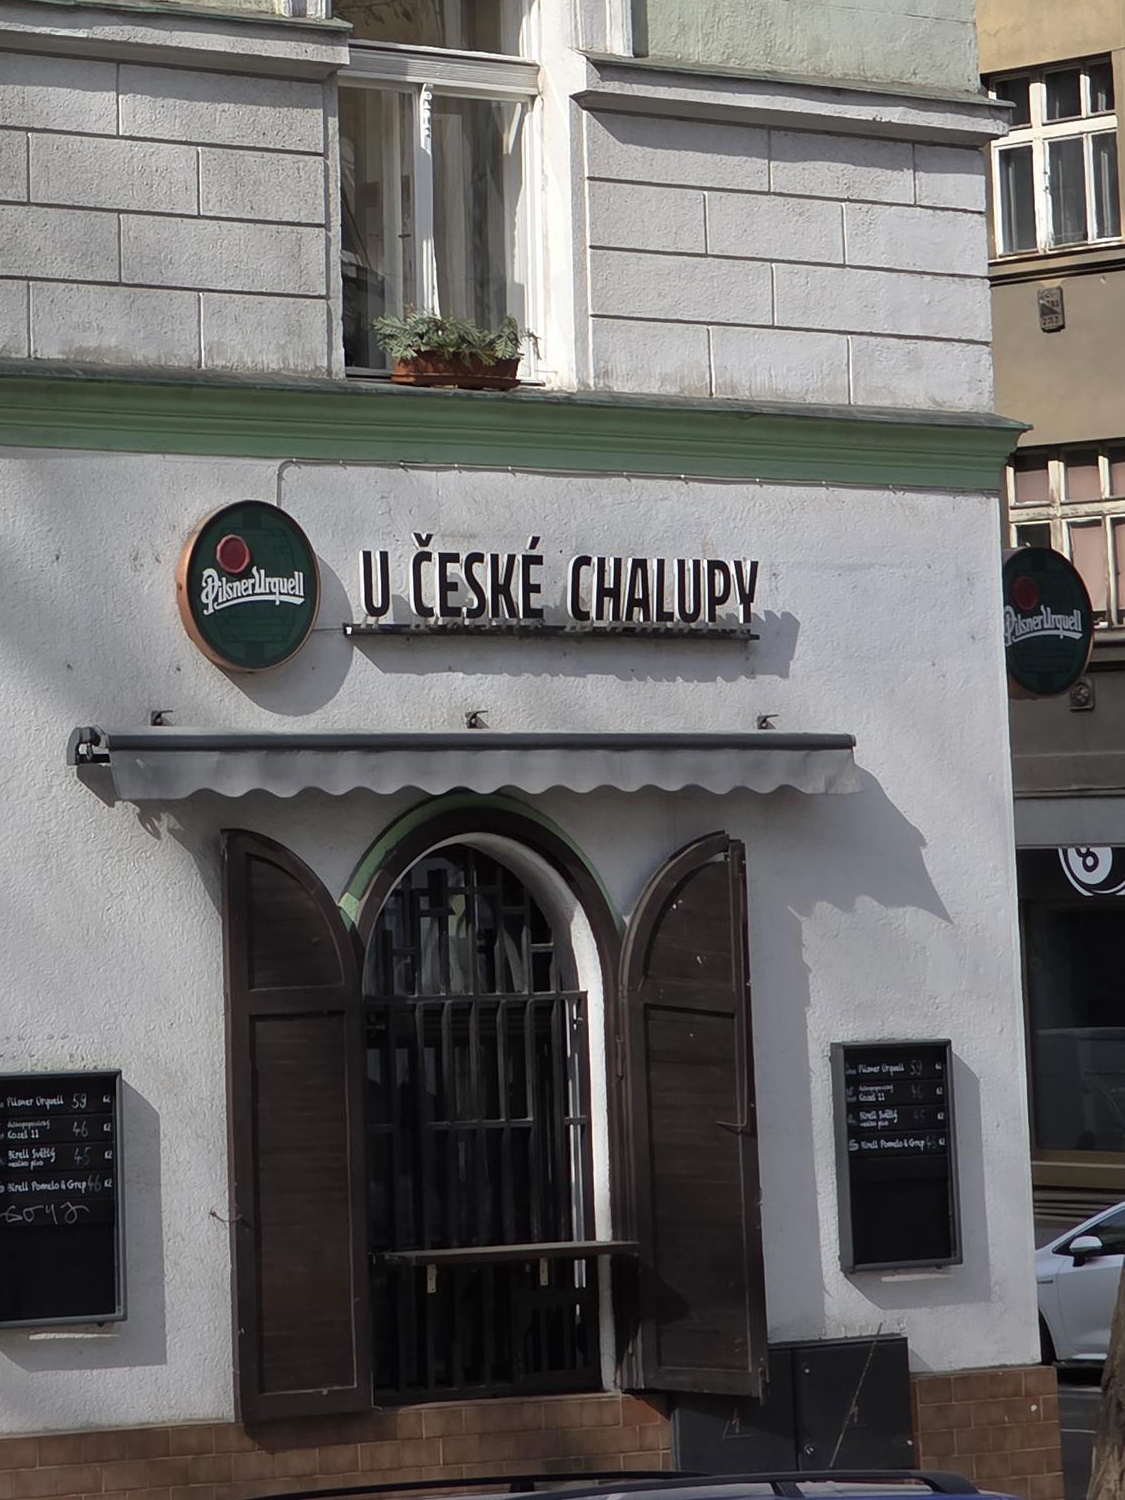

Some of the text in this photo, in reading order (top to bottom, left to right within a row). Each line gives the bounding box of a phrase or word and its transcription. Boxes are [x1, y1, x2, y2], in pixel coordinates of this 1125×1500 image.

[361, 532, 759, 624] U ČESKÉ CHALUPY
[201, 566, 304, 615] Pilsner Urquell
[1004, 604, 1082, 647] Pilsner Urquell
[7, 1097, 34, 1107] Pilsner
[36, 1095, 64, 1110] Urquell
[73, 1121, 89, 1137] 46
[74, 1147, 91, 1164] 45
[32, 1181, 59, 1191] Pomelo
[67, 1180, 86, 1194] Grep
